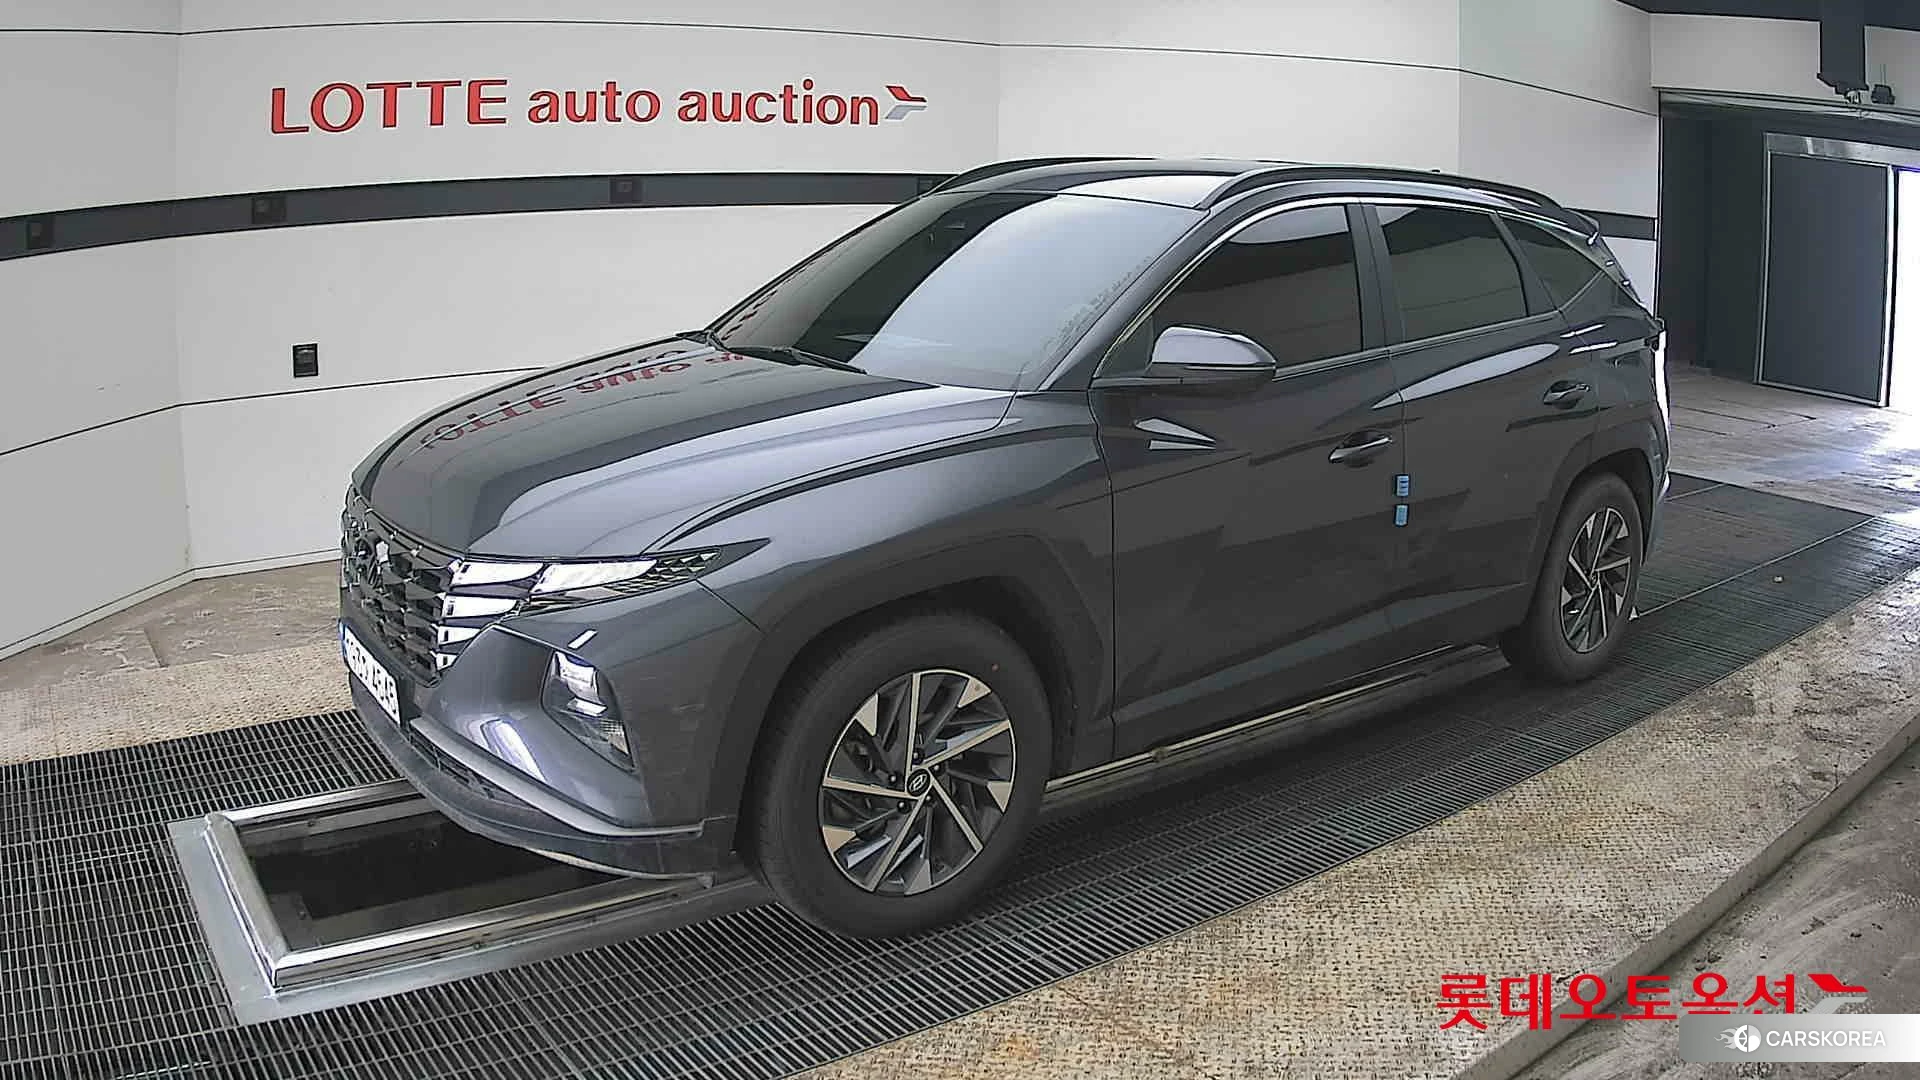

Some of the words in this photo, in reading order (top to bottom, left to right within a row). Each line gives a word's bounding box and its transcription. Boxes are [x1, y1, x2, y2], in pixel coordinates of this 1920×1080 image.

[270, 79, 507, 134] LOTTE
[527, 81, 661, 124] auto
[676, 79, 880, 125] auction
